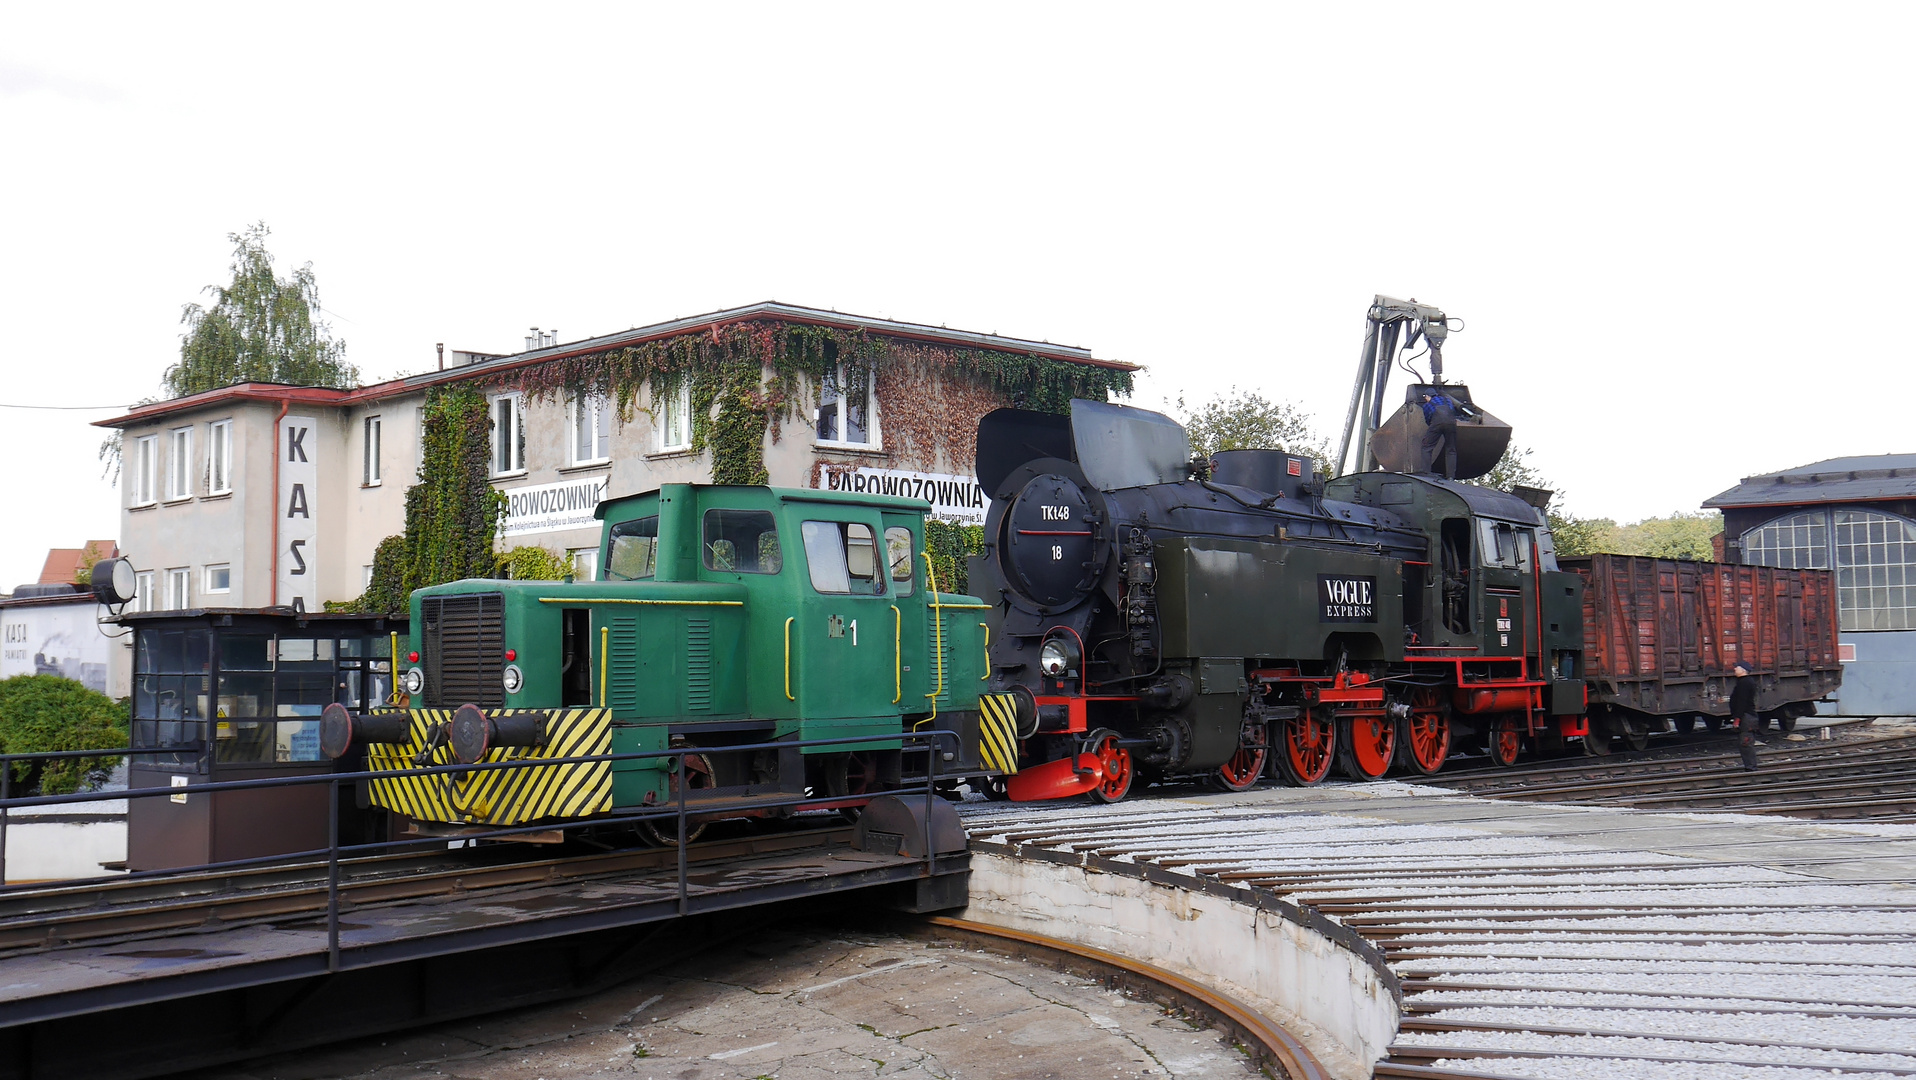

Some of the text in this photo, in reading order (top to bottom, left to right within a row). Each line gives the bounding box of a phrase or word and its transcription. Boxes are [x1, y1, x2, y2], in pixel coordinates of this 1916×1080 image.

[938, 511, 975, 523] Jaworzynie
[976, 511, 984, 523] Śl.
[1040, 505, 1070, 520] TKt48
[514, 520, 540, 531] Kolejnictwa
[1051, 545, 1062, 560] 18
[1325, 579, 1372, 605] VOGUE
[1326, 605, 1372, 617] EXPRESS
[5, 624, 27, 644] KASA
[849, 619, 857, 646] 1
